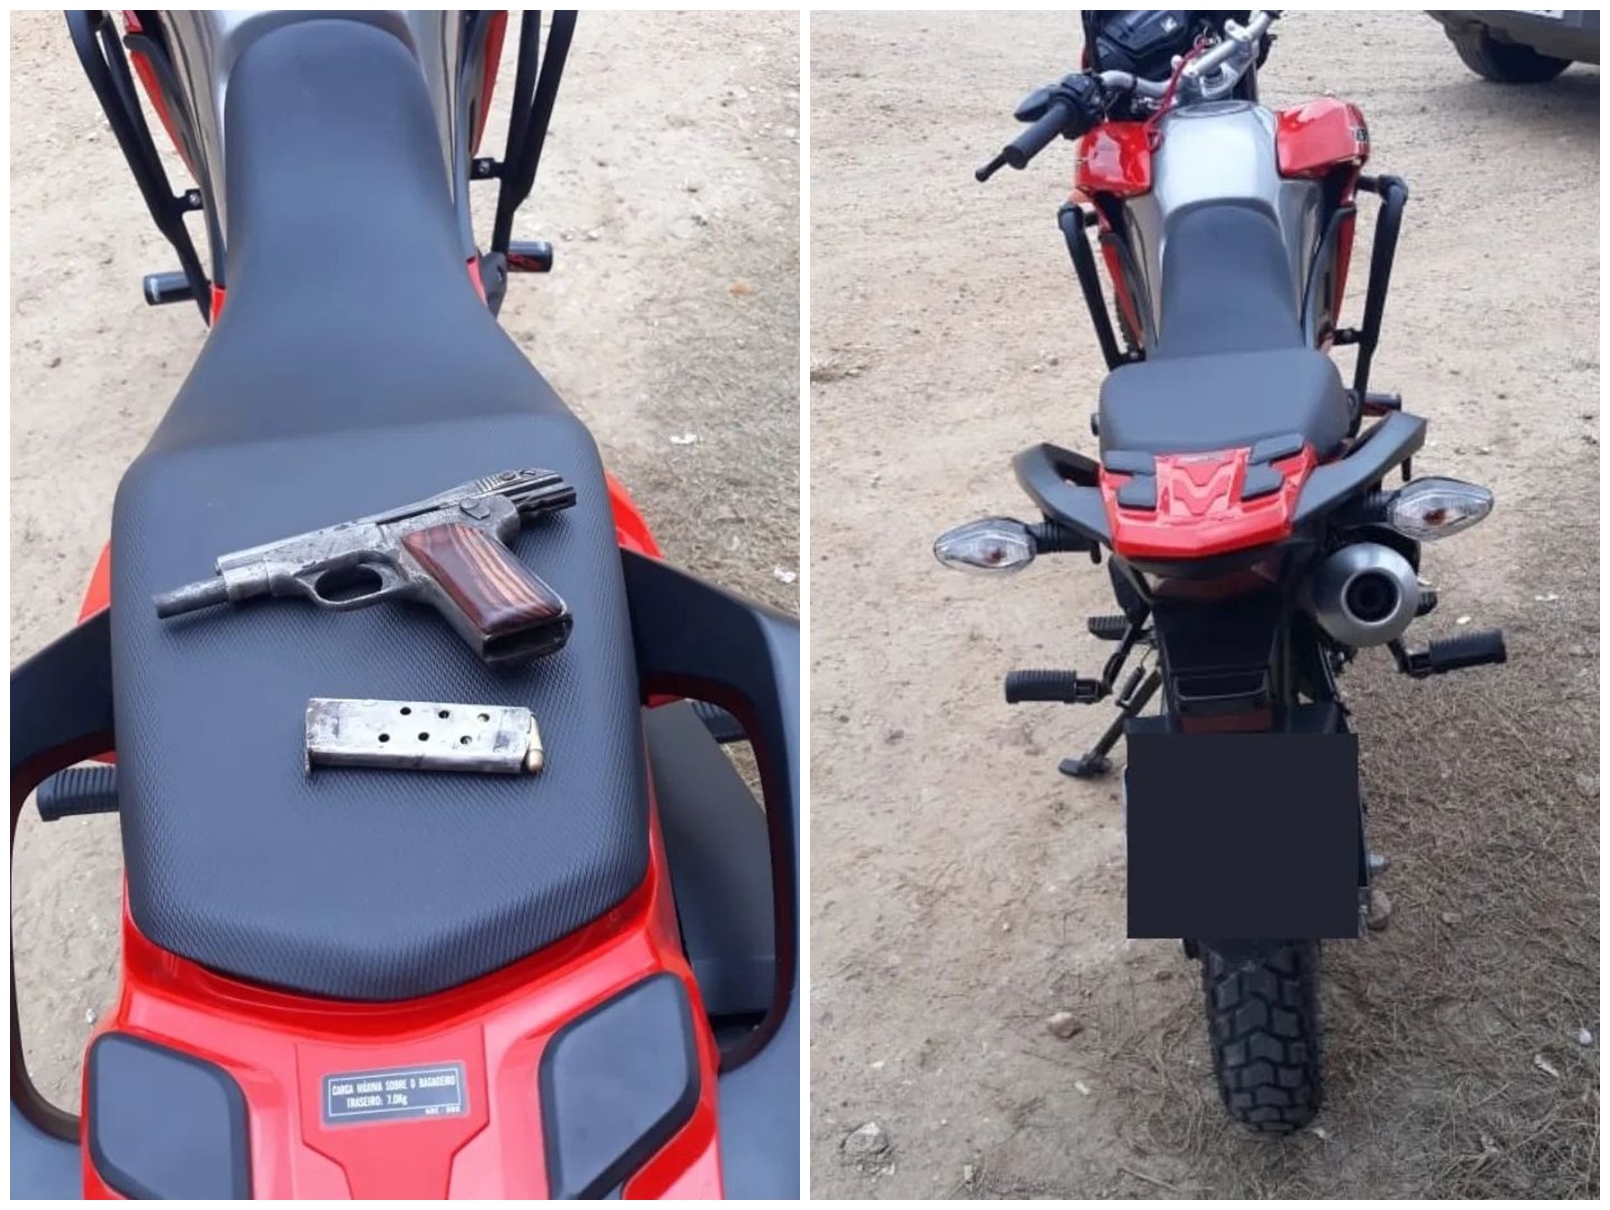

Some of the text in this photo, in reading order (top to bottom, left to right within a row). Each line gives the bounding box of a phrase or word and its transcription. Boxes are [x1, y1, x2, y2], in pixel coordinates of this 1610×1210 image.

[332, 1084, 354, 1096] CARGA
[385, 1079, 407, 1091] SOBRE
[410, 1078, 416, 1089] O
